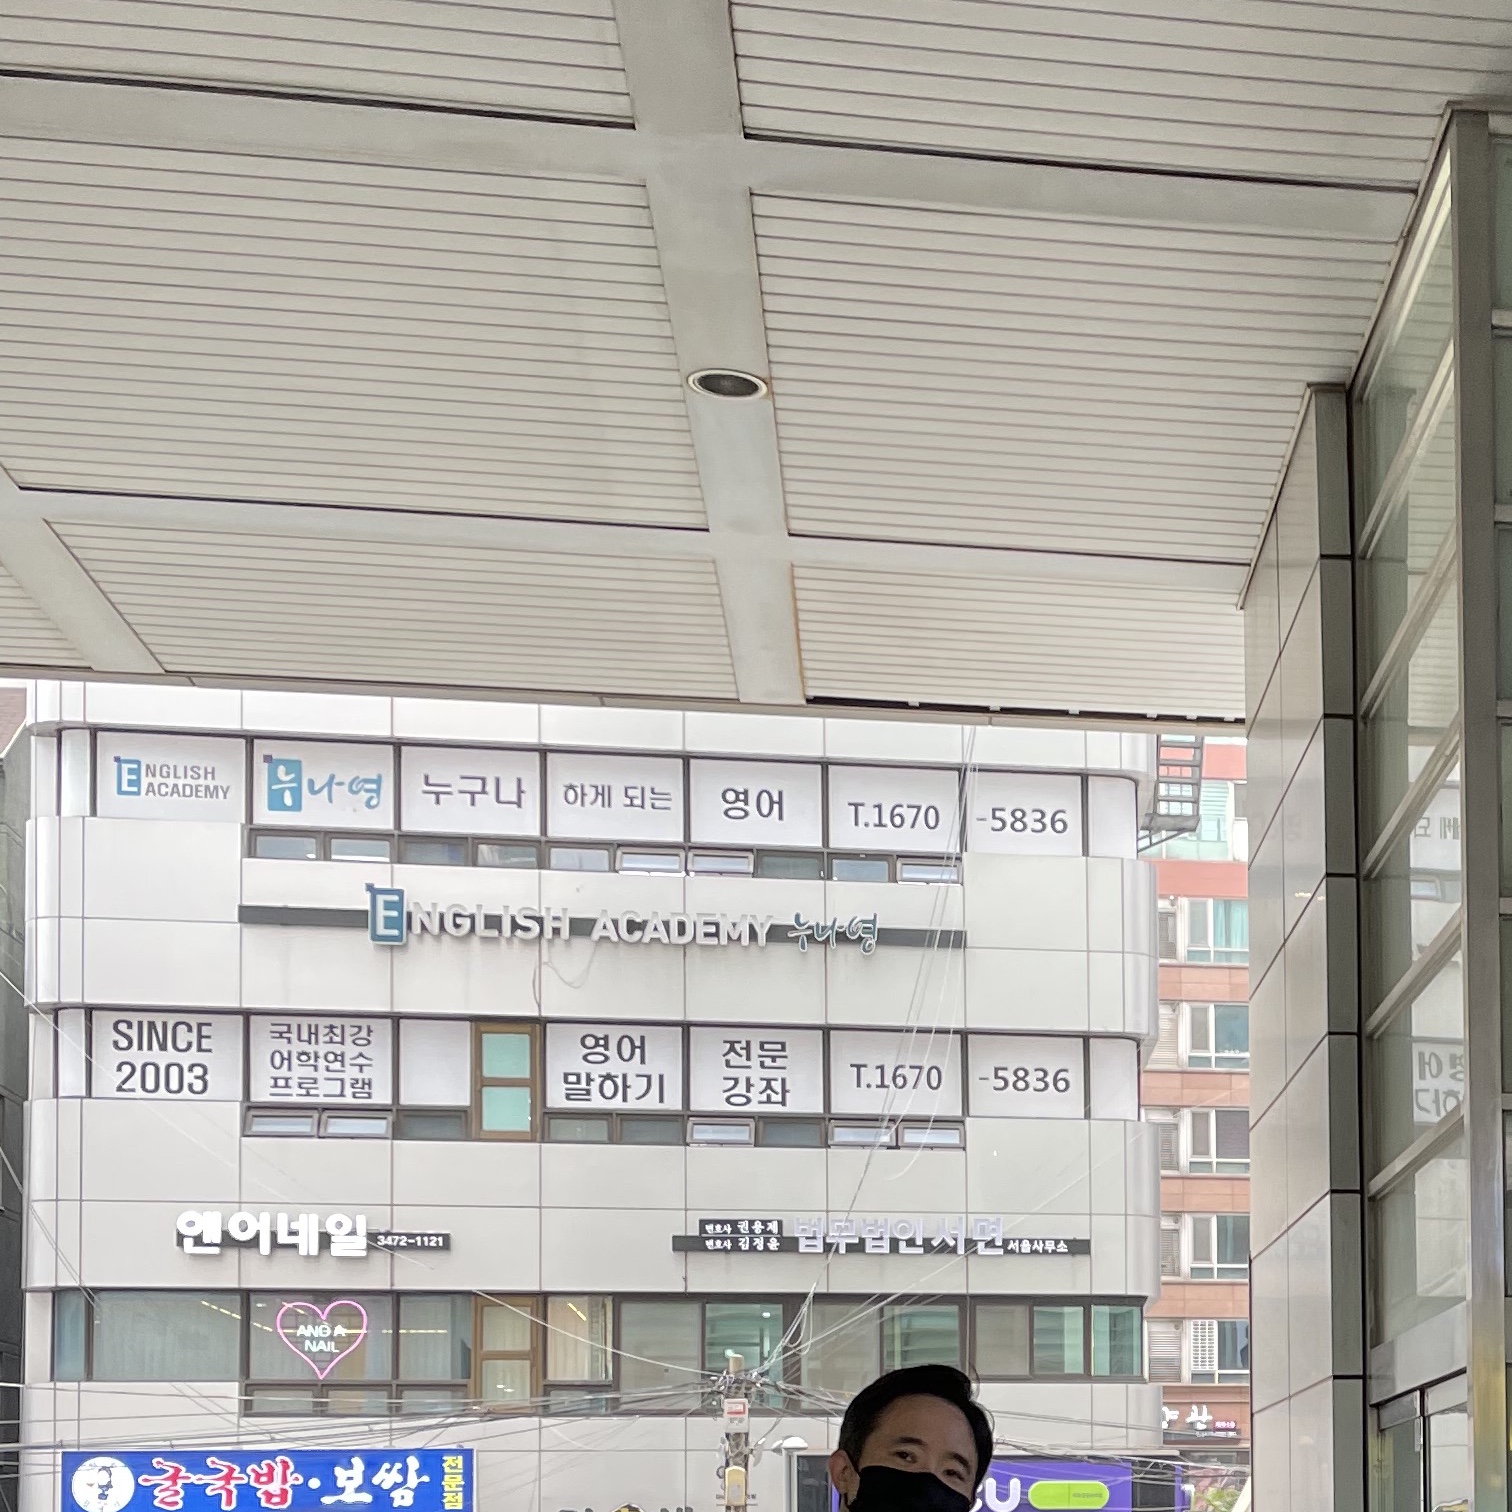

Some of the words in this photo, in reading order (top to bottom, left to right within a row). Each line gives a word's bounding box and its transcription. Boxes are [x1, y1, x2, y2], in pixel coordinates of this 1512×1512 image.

[120, 763, 216, 792] ENGLISH
[145, 782, 230, 800] ACADEMY
[421, 774, 526, 808] 누구나
[563, 782, 613, 809] 하게
[623, 785, 672, 811] 되는
[721, 788, 784, 822] 영어
[848, 801, 940, 831] T.1670
[976, 807, 1068, 834] -5836
[369, 884, 571, 944] ENGLISH
[590, 909, 774, 948] ACADEMY
[112, 1019, 213, 1054] SINCE
[269, 1022, 373, 1047] 국내최강
[579, 1033, 647, 1066] 영어
[269, 1048, 373, 1074] 어학연수
[721, 1038, 788, 1070] 전문
[115, 1061, 209, 1095] 2003
[268, 1075, 373, 1101] 프로그램
[563, 1072, 665, 1104] 말하기
[721, 1076, 791, 1107] 강좌
[850, 1062, 942, 1091] T.1670
[978, 1067, 1071, 1094] -5836
[176, 1210, 367, 1257] 앤어네일
[376, 1234, 444, 1247] 3472-1121
[1007, 1239, 1069, 1253] 서울사무소
[304, 1340, 340, 1353] NAIL
[442, 1455, 463, 1511] 전문점
